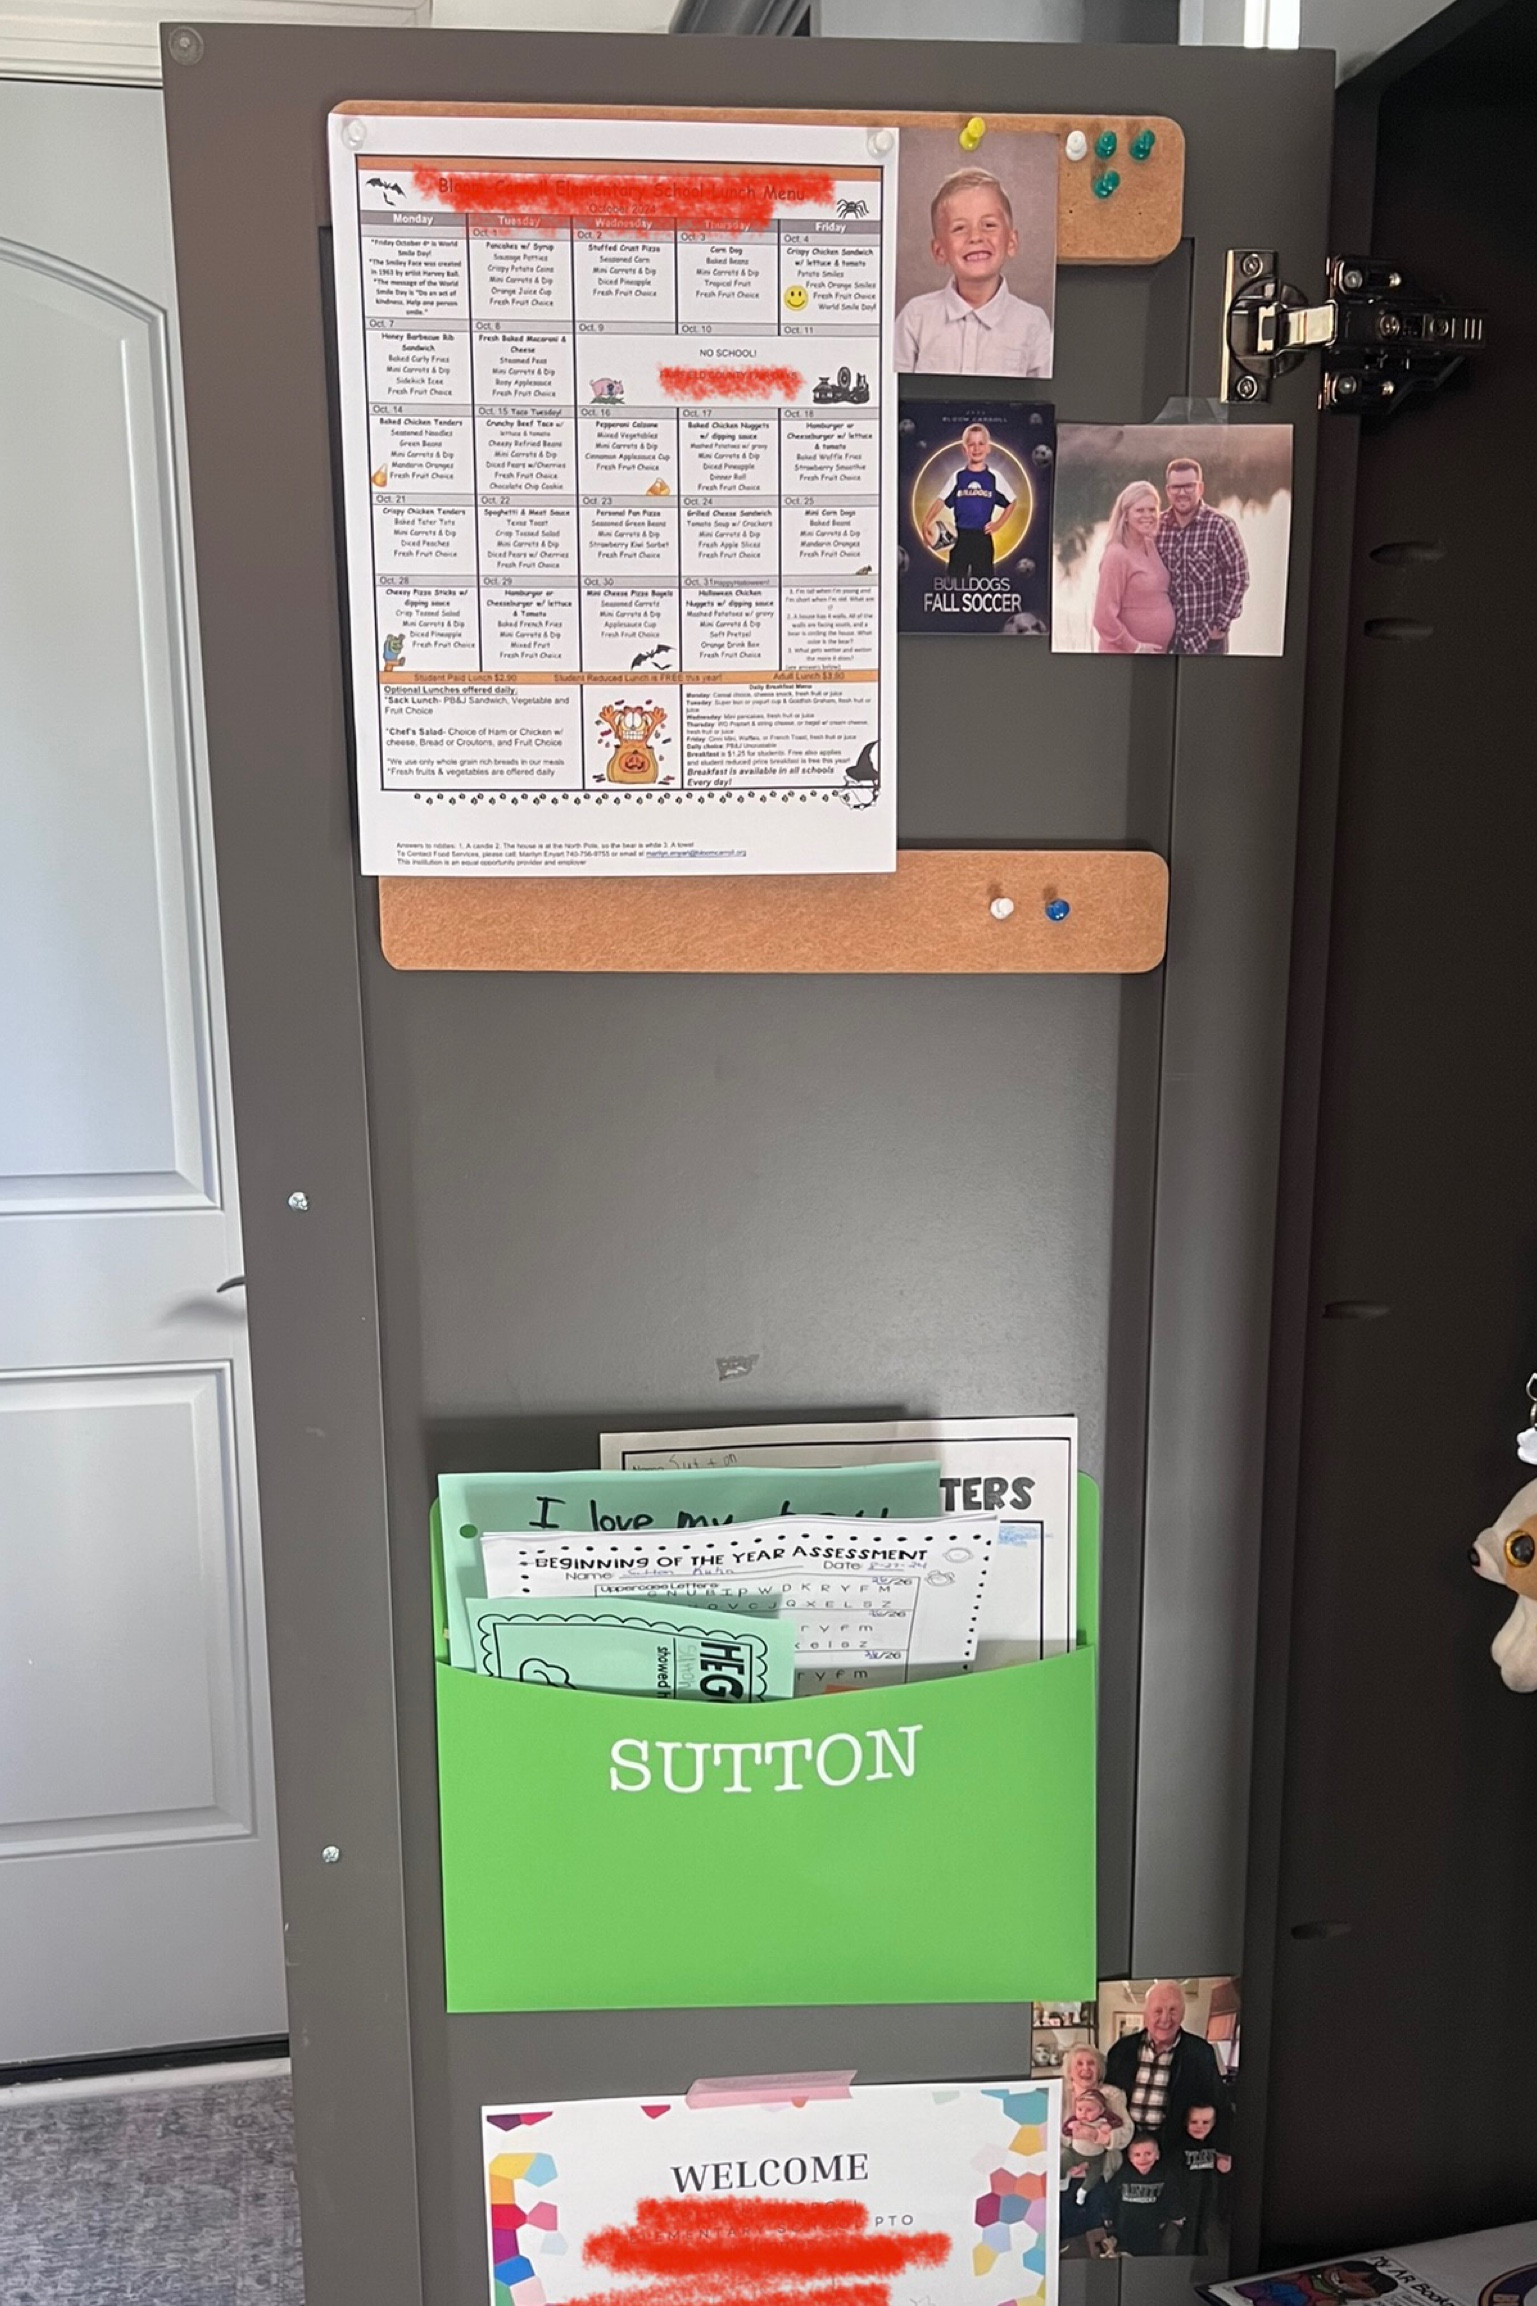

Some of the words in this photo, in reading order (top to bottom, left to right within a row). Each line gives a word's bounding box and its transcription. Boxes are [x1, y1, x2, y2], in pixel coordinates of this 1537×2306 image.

[393, 214, 434, 225] Monday
[499, 215, 541, 228] Tuesday
[595, 219, 652, 229] Wednesday
[705, 221, 751, 231] Thursday
[815, 222, 847, 232] Friday
[473, 228, 490, 236] Oct.
[577, 230, 595, 239] Oct.
[597, 231, 602, 239] 2
[681, 232, 697, 241] Oct.
[700, 233, 706, 241] 3
[784, 235, 800, 243] Oct.
[803, 235, 809, 243] 4
[730, 247, 742, 256] Dog
[787, 248, 810, 257] Crispy
[369, 320, 387, 328] Oct.
[389, 320, 394, 328] 7
[476, 322, 493, 330] Oct.
[495, 322, 500, 330] 8
[579, 324, 596, 332] Oct.
[598, 324, 604, 332] 9
[682, 325, 699, 333] Oct.
[702, 325, 712, 333] 10
[784, 326, 802, 334] Oct.
[804, 326, 813, 334] 11
[382, 333, 404, 342] Honey
[407, 333, 440, 341] Barbecue
[526, 335, 558, 343] Macaroni
[560, 335, 566, 343] &
[700, 349, 714, 357] NO
[717, 349, 756, 357] SCHOOL!
[479, 407, 496, 415] Oct.
[532, 408, 561, 417] Tuesday!
[784, 410, 801, 418] Oct.
[380, 418, 401, 426] Baked
[404, 418, 432, 426] Chicken
[435, 418, 462, 426] Tenders
[741, 422, 769, 430] Nuggets
[376, 495, 393, 503] Oct.
[383, 508, 405, 516] Crispy
[643, 510, 661, 518] Pizza
[840, 510, 856, 518] Dogs
[584, 578, 601, 586] Oct.
[934, 577, 1010, 591] BULLDOGS
[924, 594, 960, 613] FALL
[962, 594, 1022, 613] SOCCER
[414, 674, 448, 682] Student
[450, 674, 465, 682] Paid
[468, 674, 493, 682] Lunch
[495, 674, 517, 682] $2.90
[554, 675, 585, 683] Student
[660, 674, 683, 682] FREE
[702, 674, 723, 683] year!
[384, 686, 420, 695] Optional
[423, 686, 460, 694] Lunches
[462, 686, 492, 694] offered
[494, 686, 518, 695] daily.
[469, 697, 509, 705] Sandwich,
[511, 697, 552, 705] Vegetable
[419, 728, 446, 736] Salad-
[448, 728, 476, 736] Choice
[478, 728, 486, 736] of
[488, 728, 507, 736] Ham
[520, 728, 552, 736] Chicken
[554, 728, 563, 736] w/
[687, 768, 727, 776] Breakfast
[739, 767, 777, 775] available
[802, 766, 834, 774] schools
[687, 779, 712, 788] Every
[715, 778, 732, 787] day!
[939, 1477, 1036, 1512] TERS
[529, 1495, 565, 1530] I
[590, 1499, 654, 1532] love
[677, 1510, 735, 1530] my
[535, 1557, 650, 1571] BEGINNING
[656, 1556, 684, 1568] OF
[691, 1554, 723, 1566] THE
[733, 1547, 786, 1564] YEAR
[792, 1546, 928, 1562] ASSESSMENT
[823, 1560, 861, 1570] Date
[564, 1571, 613, 1581] Name
[600, 1584, 669, 1593] Uppercase
[657, 1646, 671, 1687] showed
[700, 1641, 745, 1703] HEG
[609, 1724, 924, 1794] SUTTON
[670, 2153, 870, 2193] WELCOME
[875, 2214, 915, 2229] PTO
